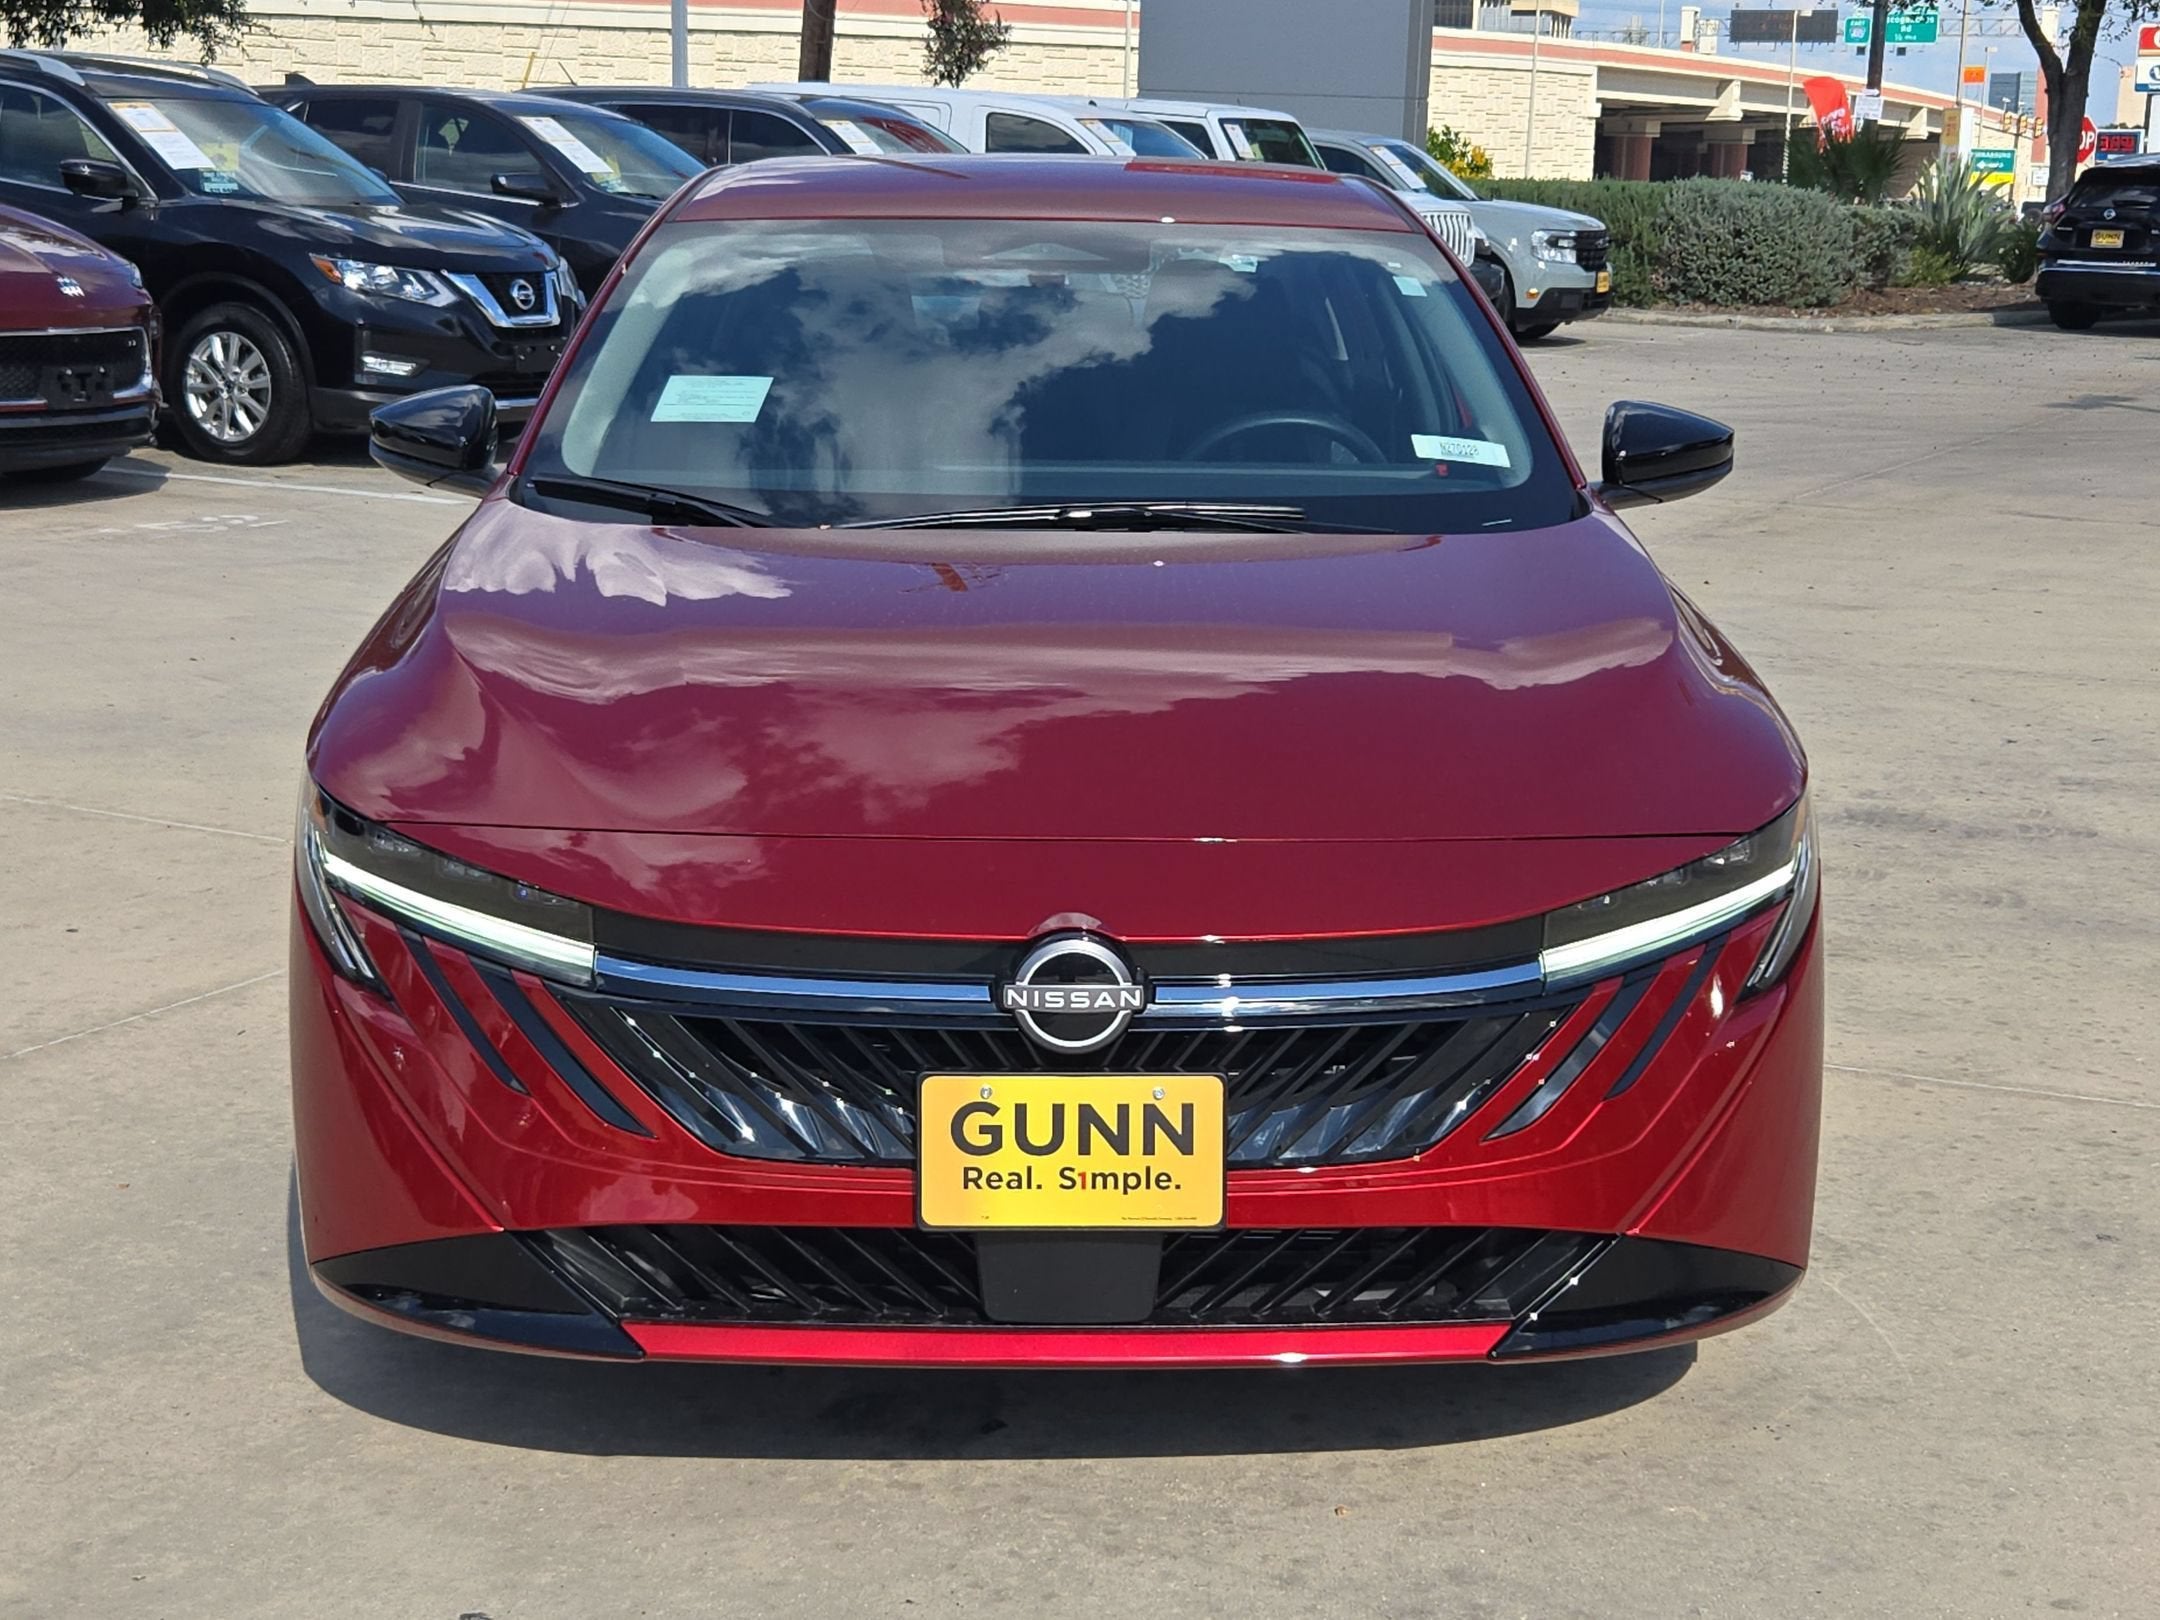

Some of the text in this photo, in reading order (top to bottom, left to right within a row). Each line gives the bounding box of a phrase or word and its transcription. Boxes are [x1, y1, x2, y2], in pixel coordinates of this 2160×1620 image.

[1007, 989, 1141, 1008] NISSAN
[950, 1101, 1194, 1156] GUNN
[963, 1166, 1181, 1195] Real. S1mple.
